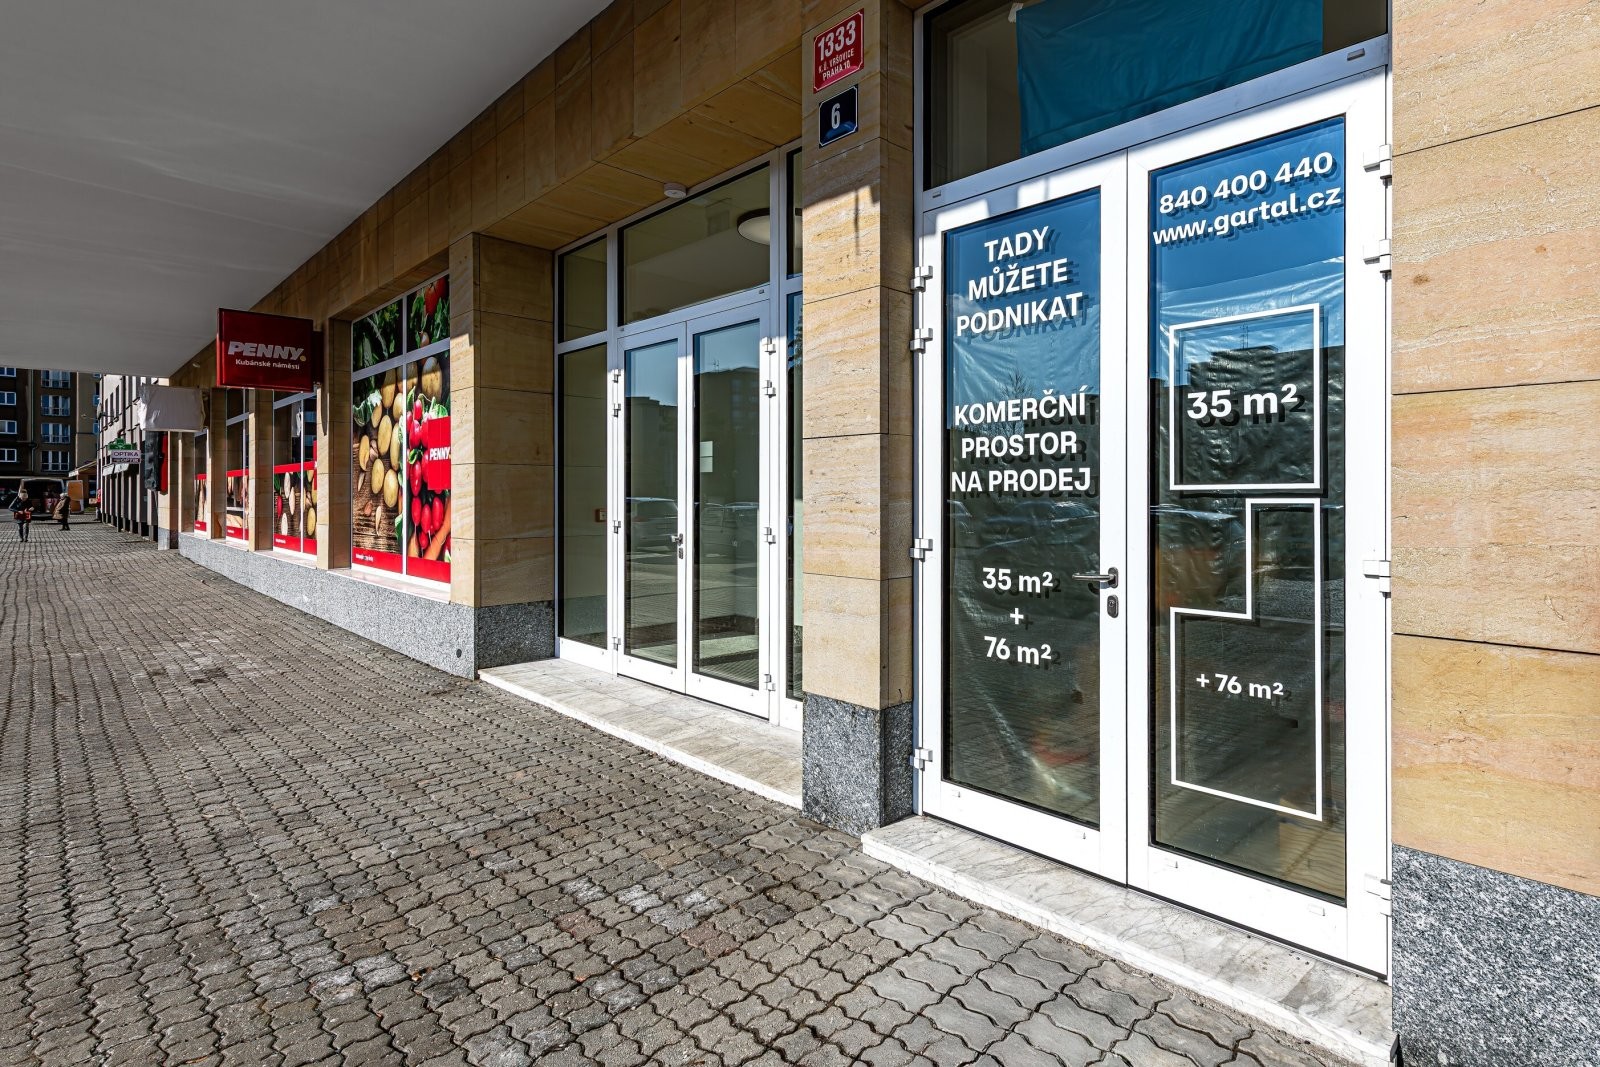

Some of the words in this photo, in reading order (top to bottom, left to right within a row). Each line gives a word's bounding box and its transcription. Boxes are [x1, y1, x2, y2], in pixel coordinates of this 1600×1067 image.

[818, 20, 856, 61] 1333
[822, 65, 843, 81] PRAHA
[843, 60, 851, 71] 10
[829, 48, 855, 68] VRŠOVICE
[831, 103, 841, 129] 6
[1159, 185, 1207, 214] 840
[1213, 169, 1267, 200] 400
[1274, 151, 1333, 184] 440
[1153, 186, 1342, 245] www.gartal.cz
[984, 225, 1049, 263] TADY
[968, 258, 1068, 301] MŮŽETE
[956, 292, 1083, 337] PODNIKAT
[235, 358, 271, 368] Kubánské
[272, 361, 300, 370] náměstí
[955, 385, 1087, 426] KOMERČNÍ
[1187, 389, 1232, 420] 35
[961, 431, 1077, 459] PROSTOR
[951, 471, 983, 492] NA
[988, 467, 1091, 492] PRODEJ
[982, 567, 1012, 590] 35
[984, 635, 1011, 660] 76
[1215, 673, 1242, 694] 76
